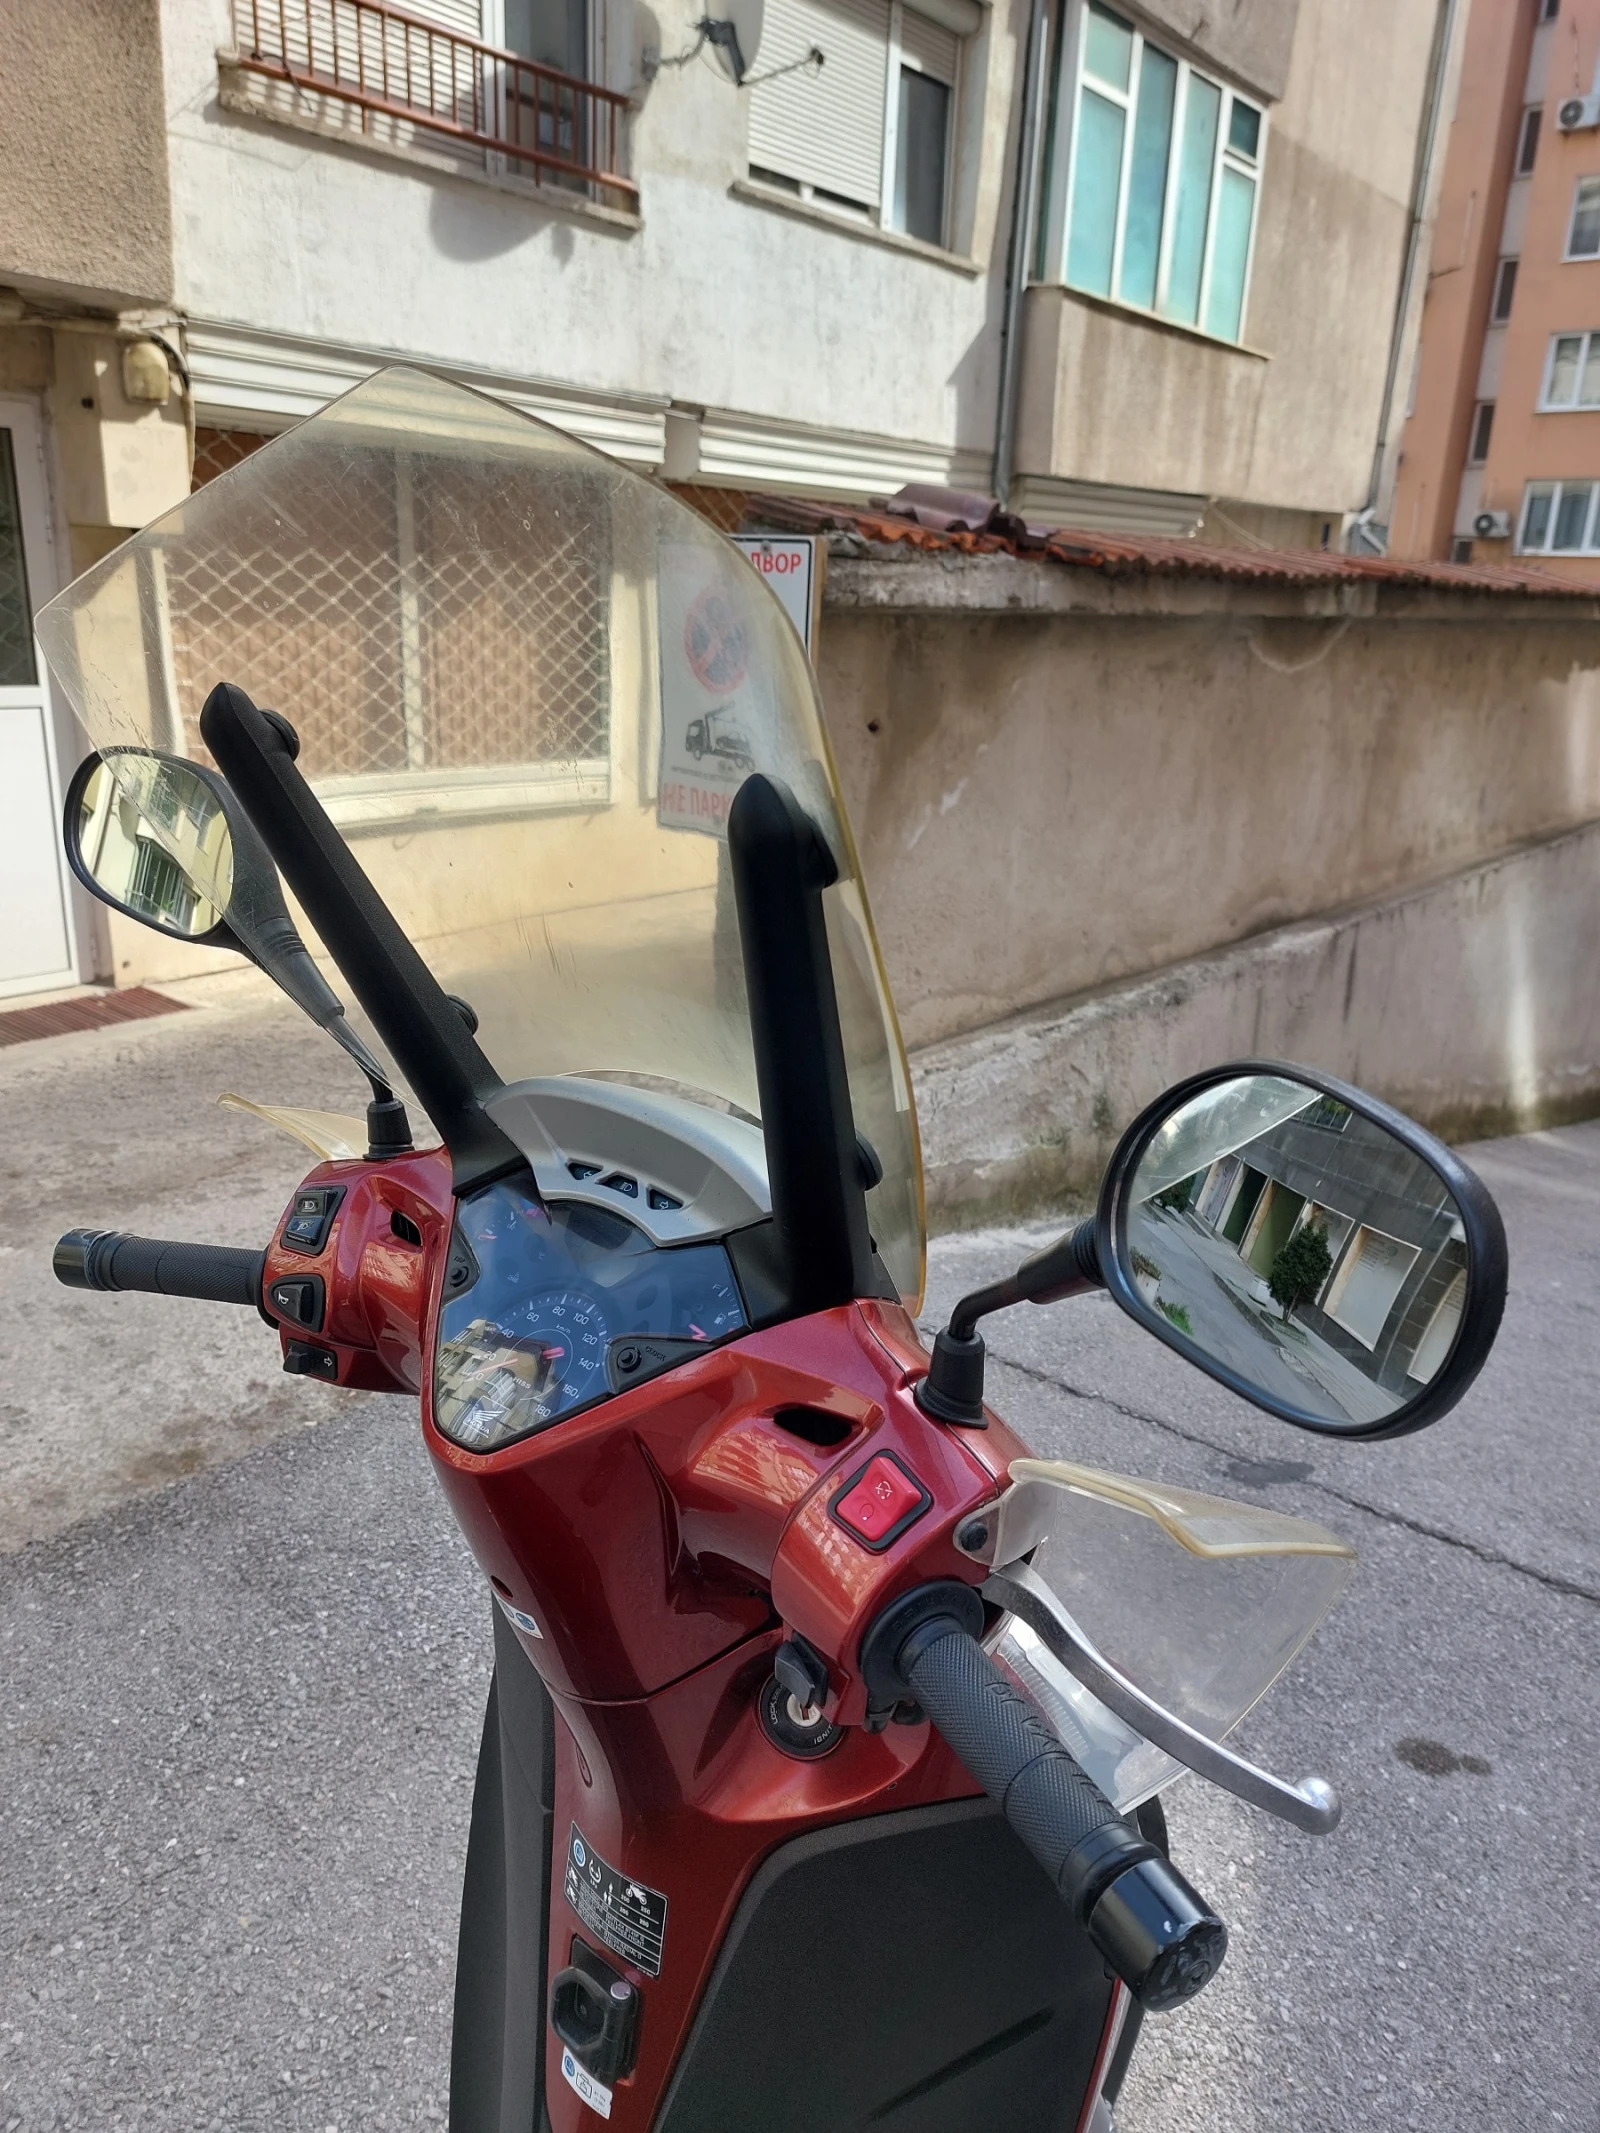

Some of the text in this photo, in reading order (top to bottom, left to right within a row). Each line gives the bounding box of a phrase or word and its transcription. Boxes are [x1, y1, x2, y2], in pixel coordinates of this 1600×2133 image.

[662, 782, 732, 822] НЕ ПАРК
[526, 1311, 539, 1322] 60
[552, 1306, 566, 1317] 80
[573, 1312, 590, 1325] 100
[501, 1328, 515, 1339] 40
[555, 1323, 571, 1334] km/h
[581, 1332, 598, 1345] 120
[483, 1350, 497, 1361] 20
[645, 1345, 668, 1362] CLOCK
[578, 1357, 595, 1370] 140
[476, 1372, 484, 1381] 0
[513, 1376, 532, 1389] HISS
[562, 1383, 579, 1397] 160
[534, 1403, 552, 1418] 180
[467, 1419, 490, 1435] HONDA
[769, 1700, 779, 1725] LOCK
[813, 1723, 834, 1745] IGNIT
